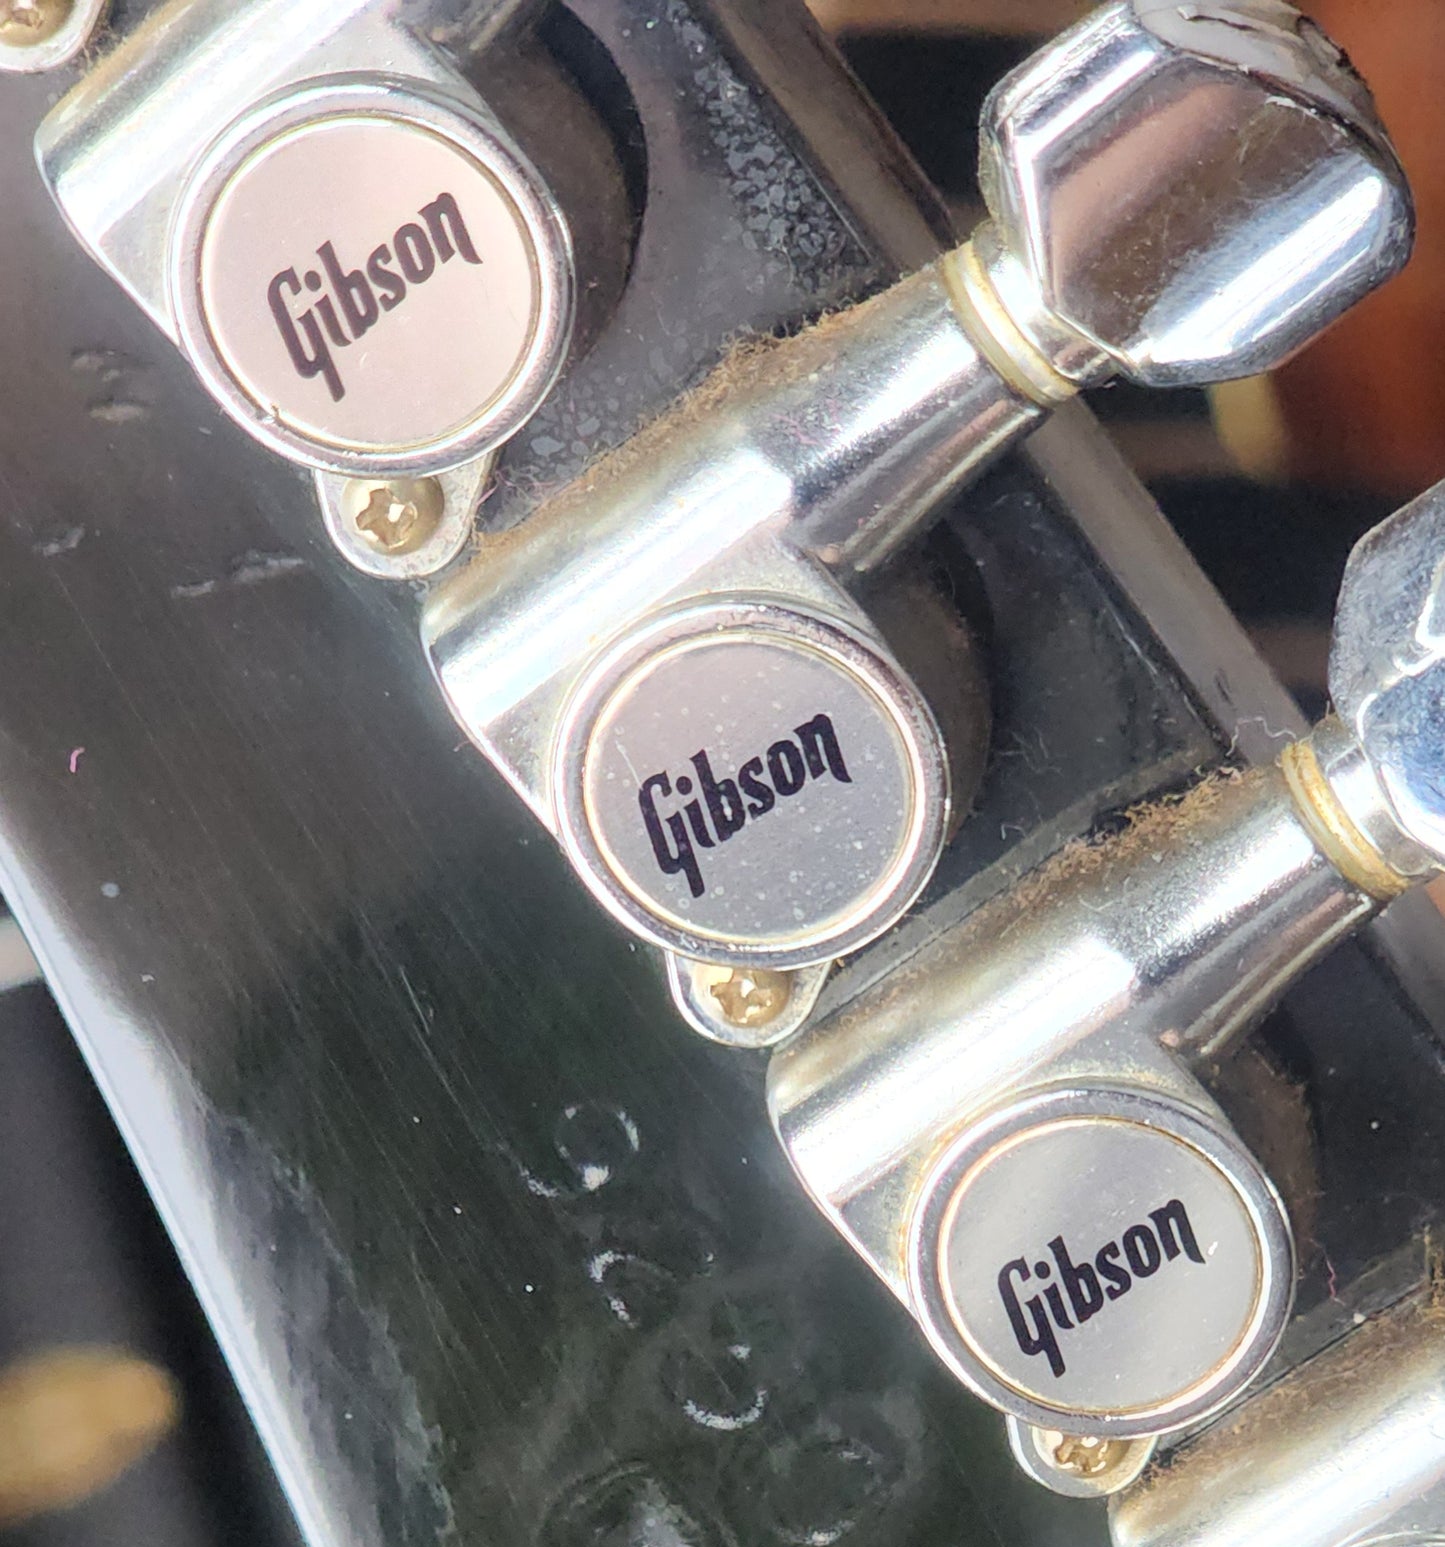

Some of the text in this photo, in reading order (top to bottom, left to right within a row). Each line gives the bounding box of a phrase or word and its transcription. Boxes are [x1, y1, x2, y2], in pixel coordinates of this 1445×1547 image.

[267, 192, 480, 403] Gibson
[639, 713, 851, 897] Gibson
[999, 1199, 1205, 1377] Gibson
